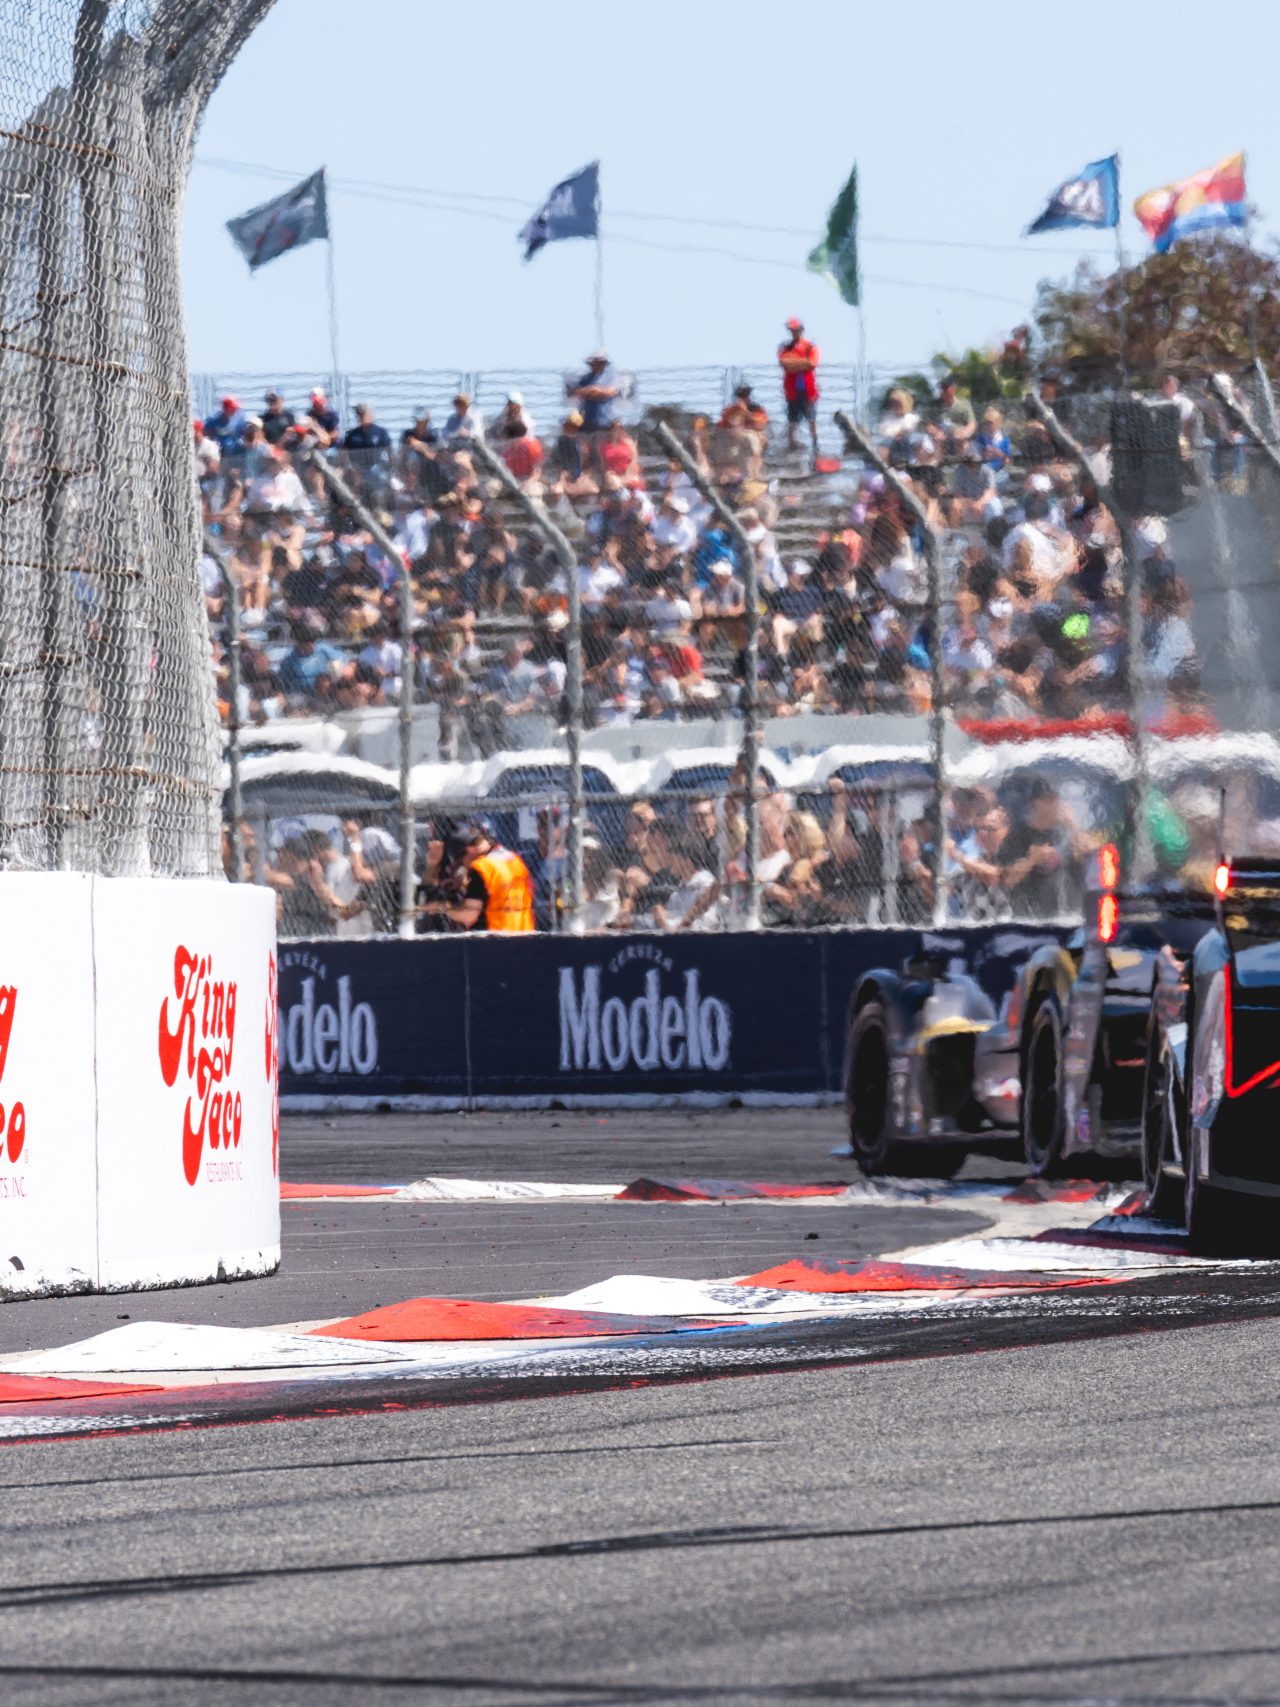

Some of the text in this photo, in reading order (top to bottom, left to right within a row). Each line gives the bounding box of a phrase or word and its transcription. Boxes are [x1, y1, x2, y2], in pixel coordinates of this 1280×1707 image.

[158, 944, 238, 1087] King
[558, 964, 732, 1071] Modelo
[182, 1046, 242, 1186] Taco
